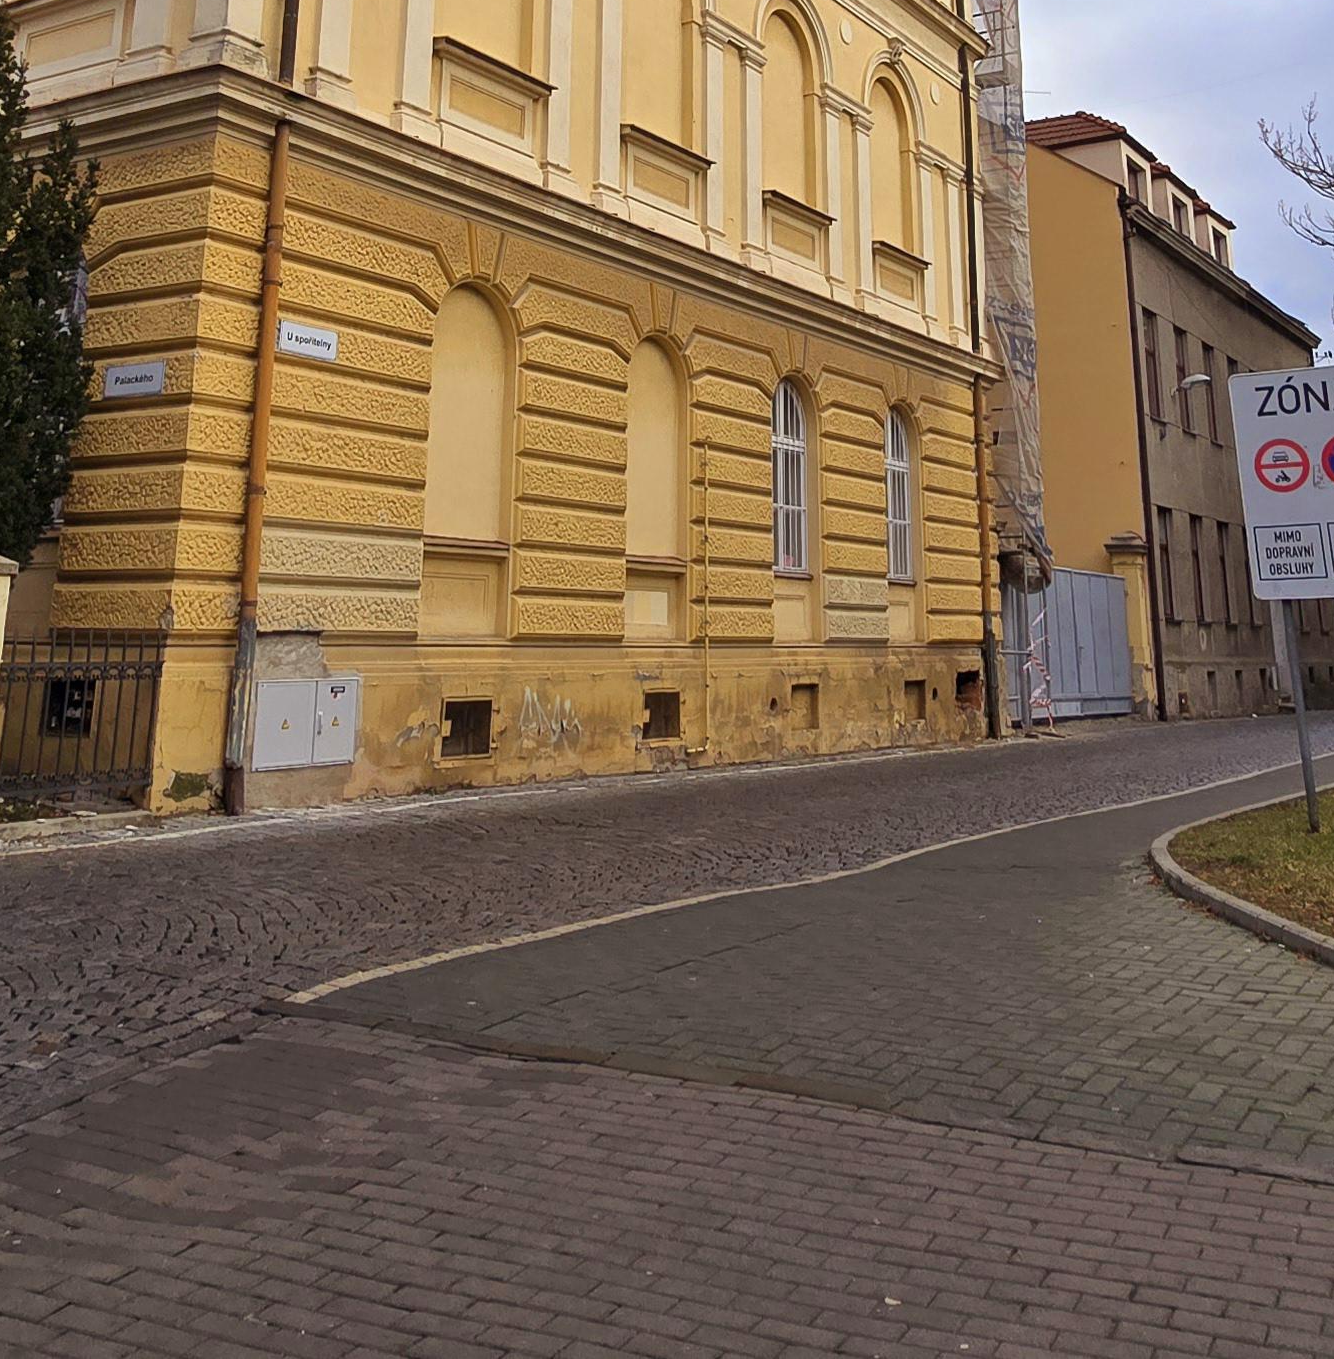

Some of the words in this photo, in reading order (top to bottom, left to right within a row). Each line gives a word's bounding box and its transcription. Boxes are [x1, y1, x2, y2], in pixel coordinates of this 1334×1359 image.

[286, 331, 294, 342] U
[295, 333, 332, 351] spořitelny
[114, 372, 154, 386] Palackého
[1273, 530, 1302, 543] MIMO
[1265, 542, 1315, 560] DOPRAVNÍ
[1269, 561, 1315, 576] OBSLUHY
